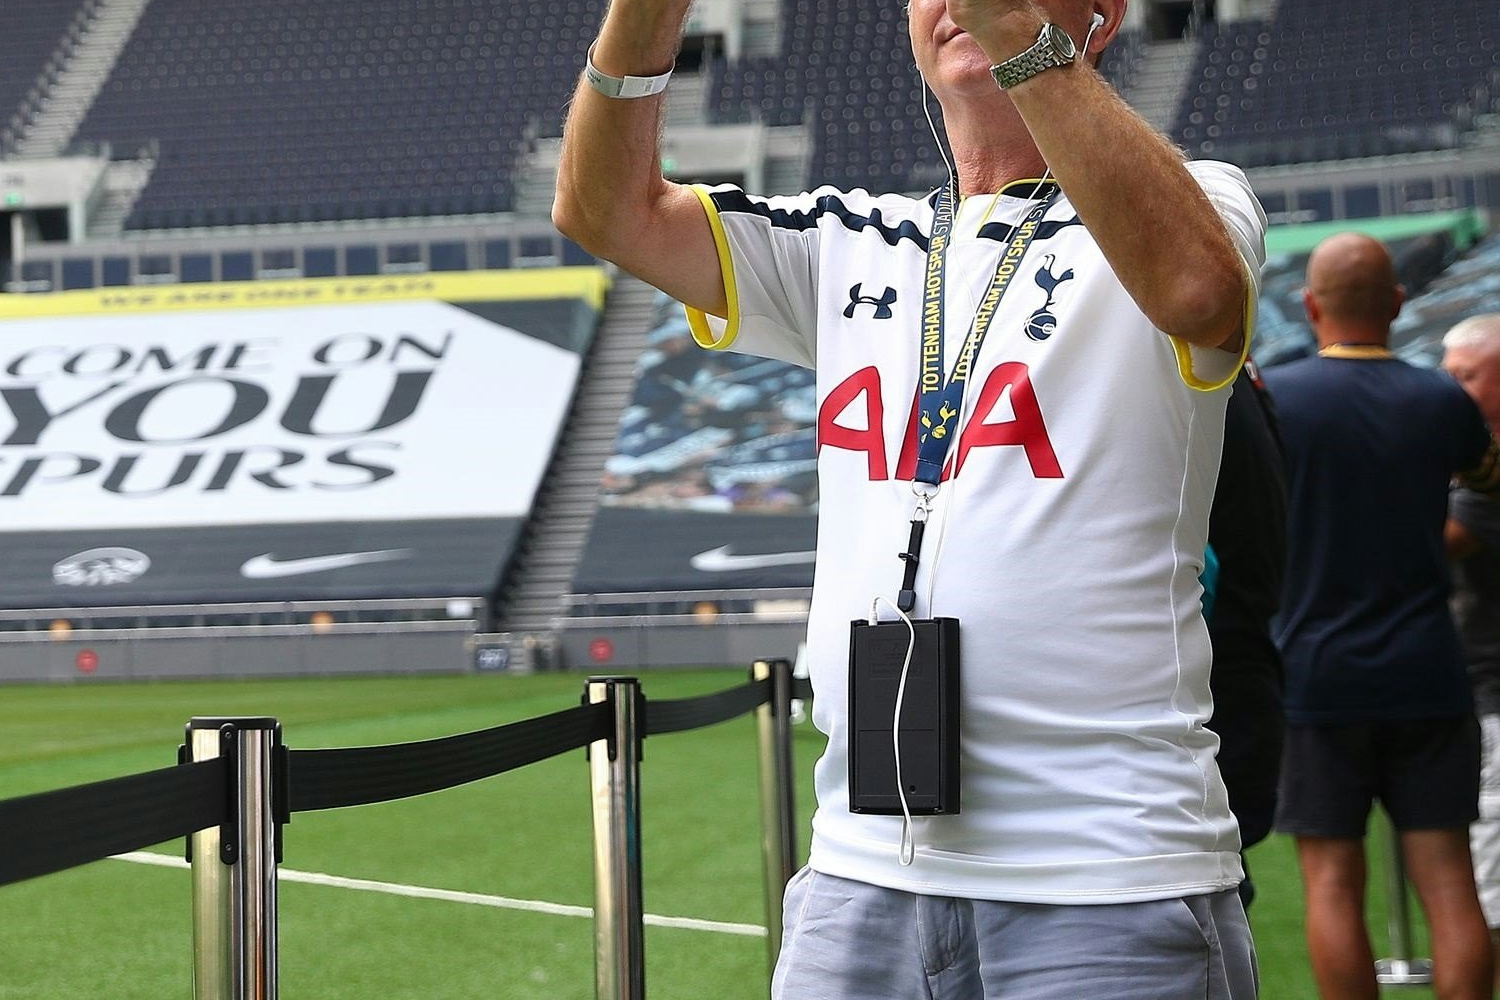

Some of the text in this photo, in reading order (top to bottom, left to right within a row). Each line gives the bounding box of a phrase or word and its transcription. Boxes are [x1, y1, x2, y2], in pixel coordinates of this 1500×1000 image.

[926, 235, 946, 299] HOTSPUR
[951, 288, 1003, 384] TOTTENHAM
[994, 221, 1036, 287] HOTSPUR
[4, 330, 454, 379] COME ON
[922, 301, 941, 394] TOTTENHAM
